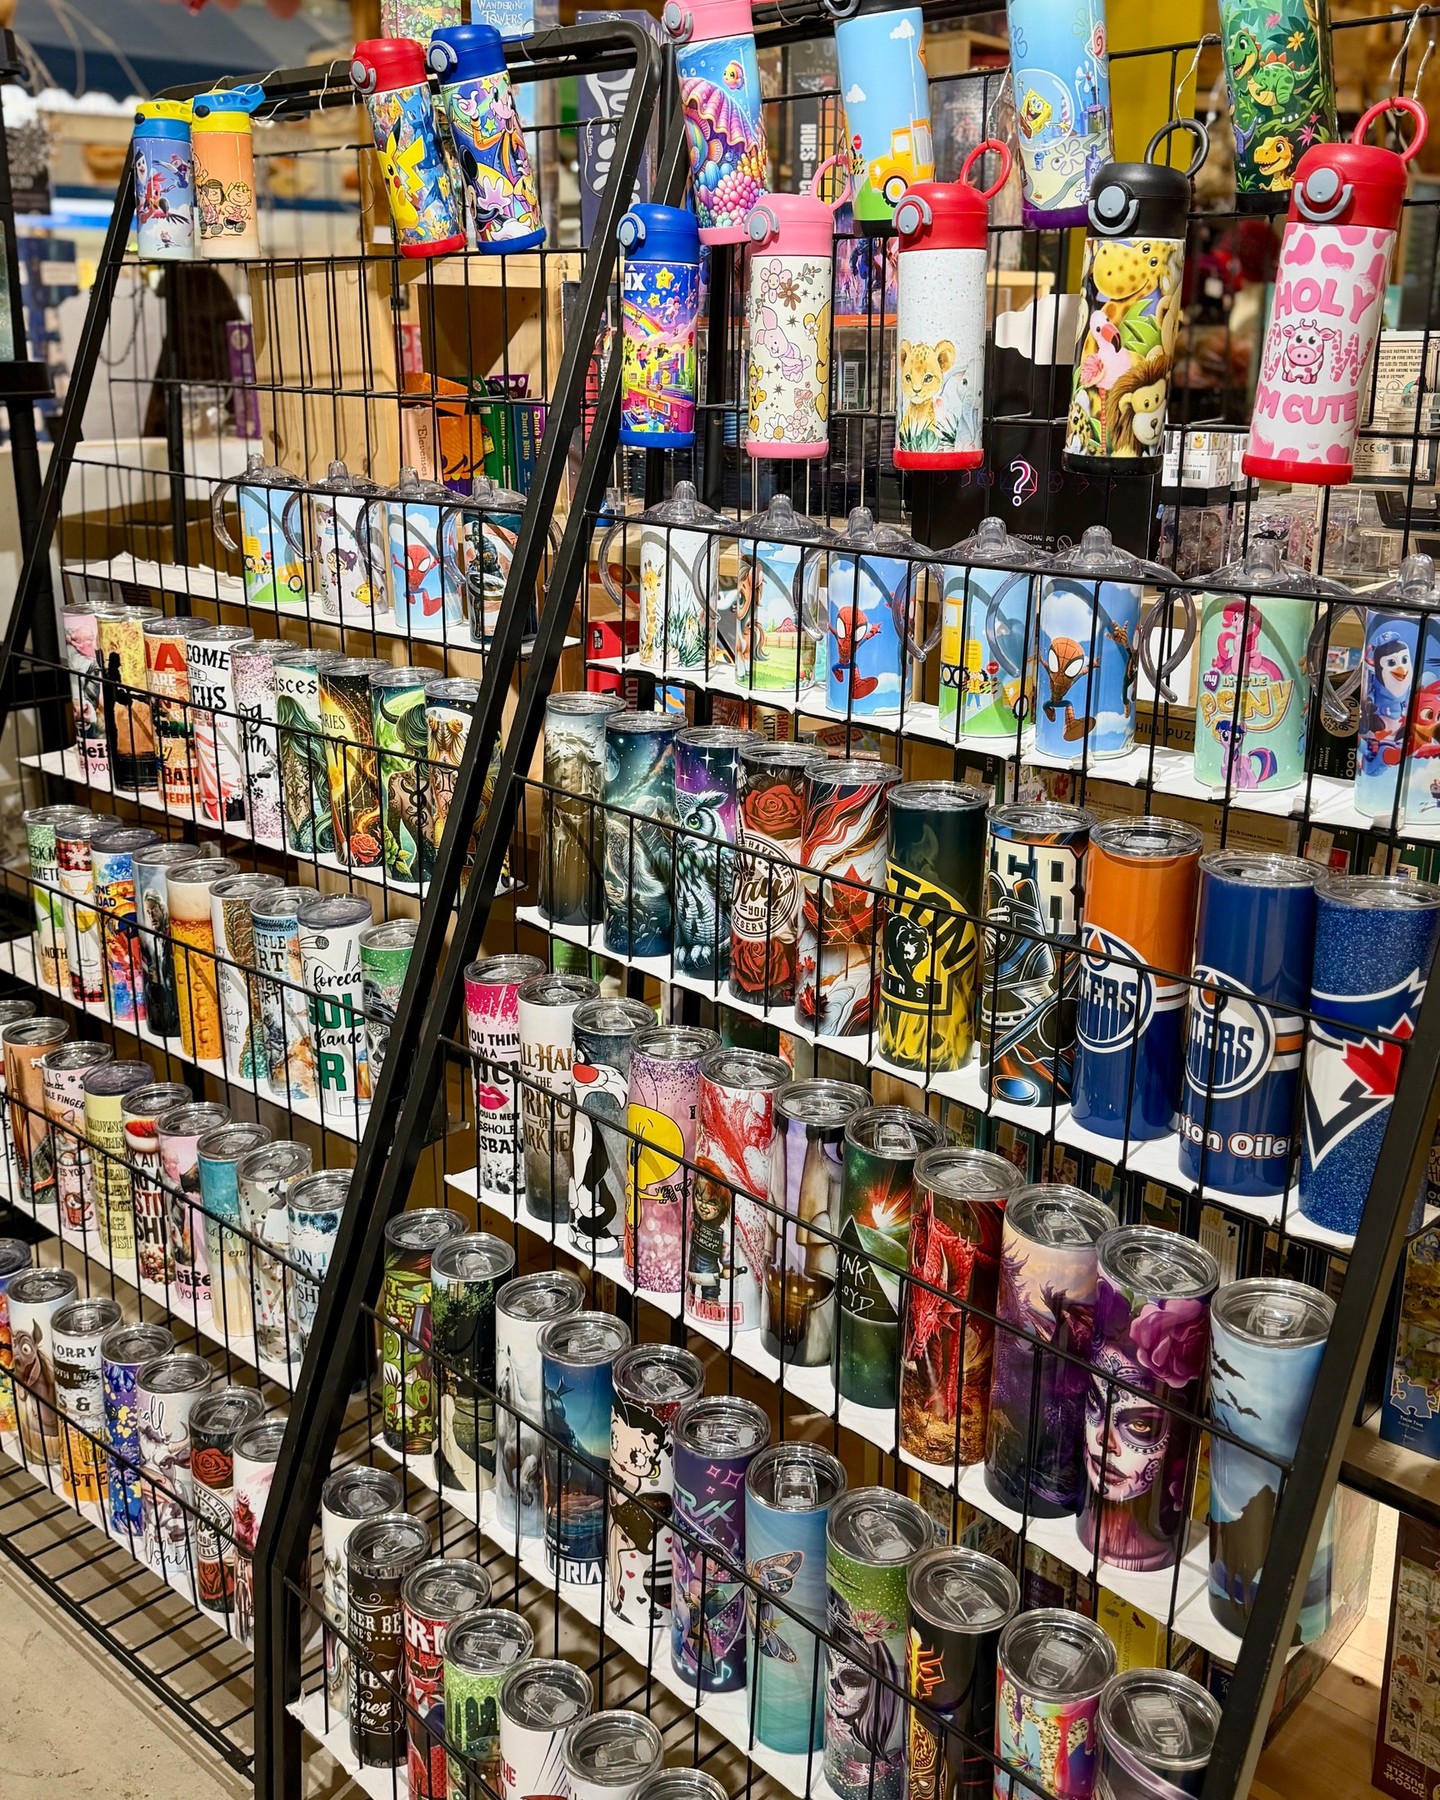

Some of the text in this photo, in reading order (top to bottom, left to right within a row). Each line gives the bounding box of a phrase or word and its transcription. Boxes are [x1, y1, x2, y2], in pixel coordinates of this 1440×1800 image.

[481, 9, 524, 26] TOWERS
[799, 124, 817, 161] HUES
[1275, 277, 1376, 324] HOLY
[1282, 391, 1359, 425] CUTE
[417, 424, 428, 477] Elevenses
[1200, 679, 1294, 732] PONY
[534, 1074, 553, 1089] THE
